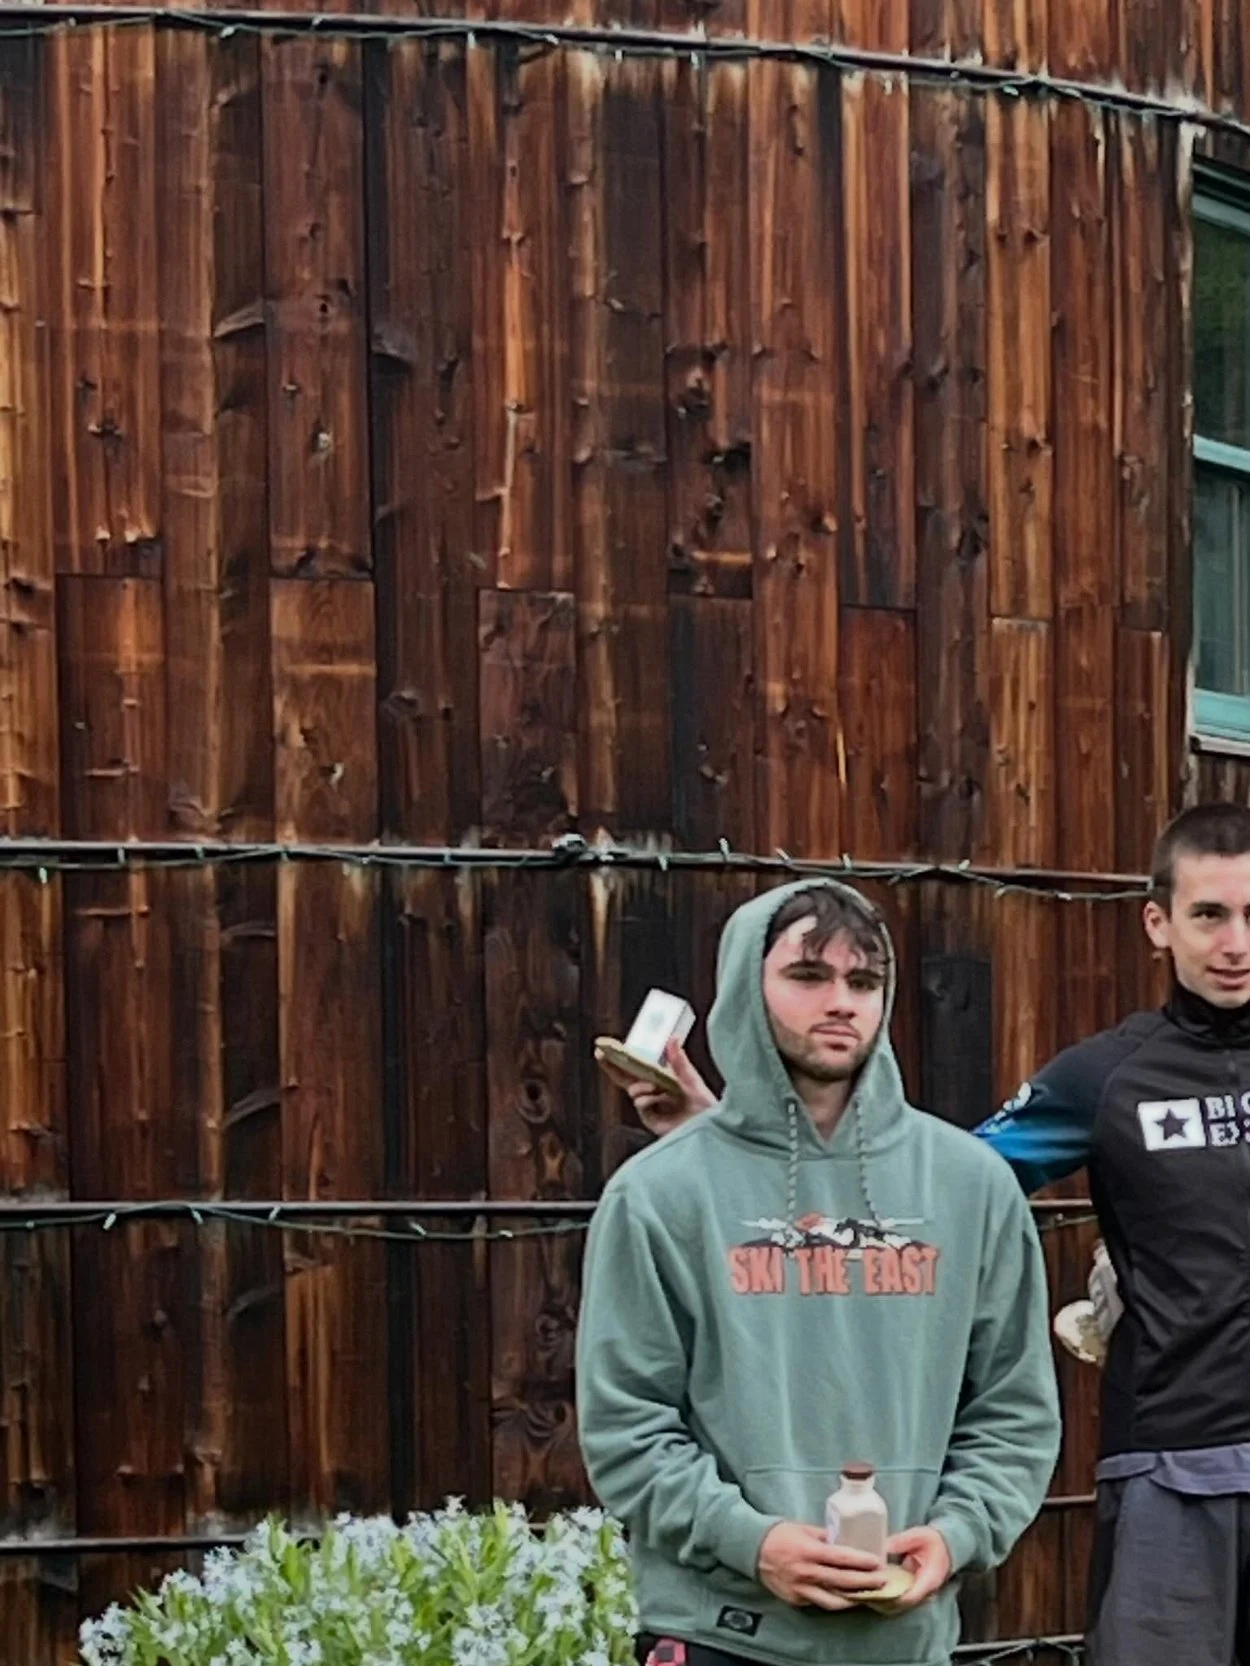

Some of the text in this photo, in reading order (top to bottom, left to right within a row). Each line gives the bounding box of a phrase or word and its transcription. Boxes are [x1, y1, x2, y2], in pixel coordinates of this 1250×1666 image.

[730, 1245, 938, 1295] SKI THE EAST
